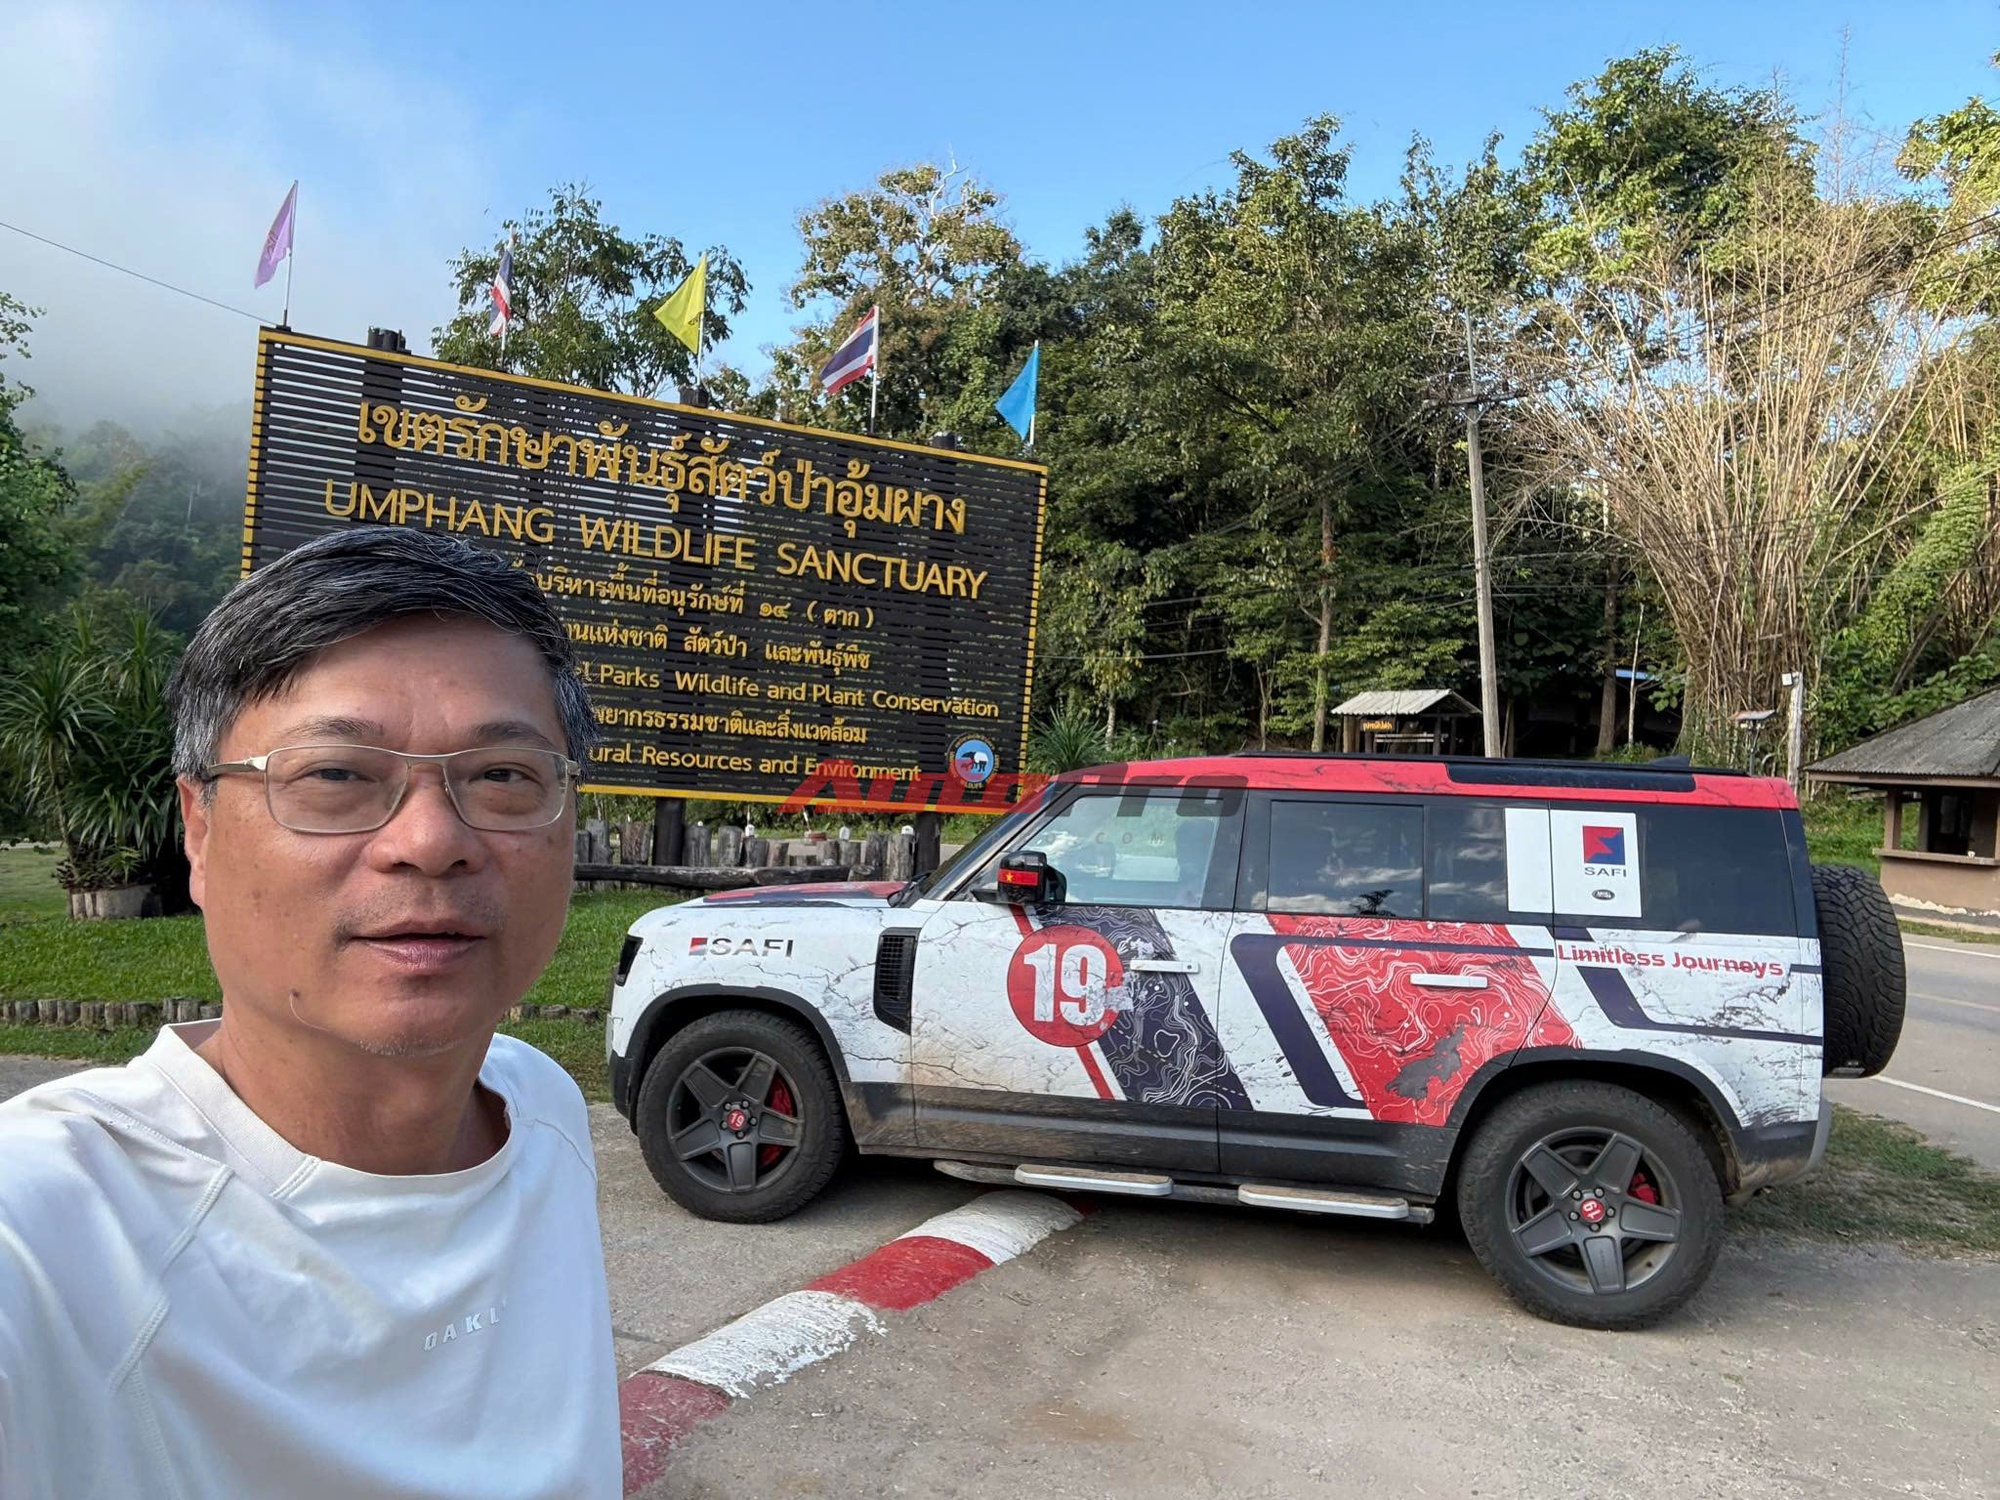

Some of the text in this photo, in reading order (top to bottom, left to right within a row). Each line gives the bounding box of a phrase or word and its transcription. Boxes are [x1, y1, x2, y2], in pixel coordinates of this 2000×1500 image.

[357, 394, 967, 538] เขตรักษาพันธุ์สัตว์ป่าอุ้มผาง
[323, 478, 988, 599] UMPHANG WILDLIFE SANCTUARY
[531, 561, 744, 616] บริหารพื้นที่อนุรักษ์ที่
[564, 618, 669, 649] านแห่งชาติ
[683, 626, 748, 657] สัตว์ป่า
[600, 663, 660, 688] Parks
[675, 670, 759, 697] Wildlife
[767, 683, 806, 702] and
[812, 683, 866, 708] Plant
[872, 691, 999, 718] Conservation
[594, 706, 867, 744] พยากรธรรมชาติและสิ่งแวดล้อม
[590, 743, 922, 782] ural Resources and Environment
[1583, 867, 1627, 878] SAFI
[710, 938, 793, 957] SAFI
[1557, 944, 1784, 979] Limitless Journeys
[1023, 943, 1107, 1026] 19
[730, 1112, 745, 1128] 19
[423, 1298, 507, 1351] OAKL
